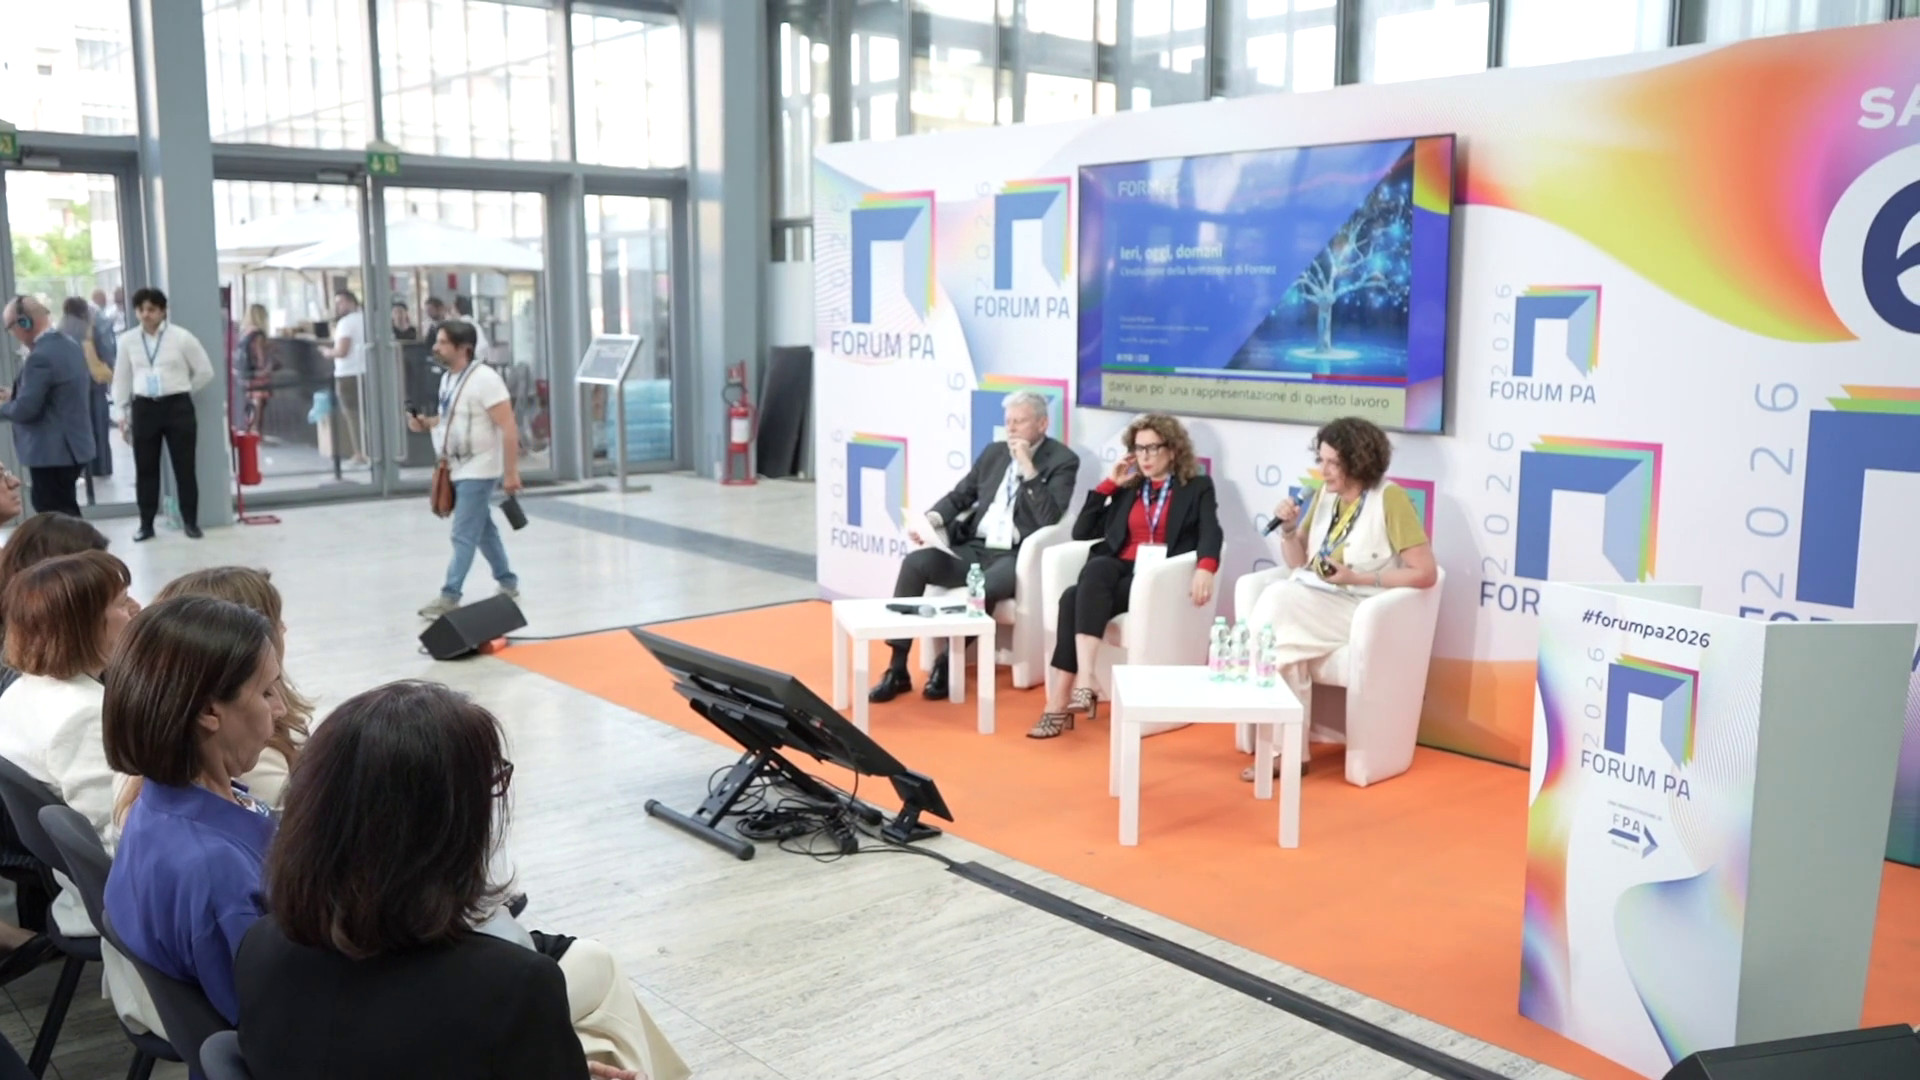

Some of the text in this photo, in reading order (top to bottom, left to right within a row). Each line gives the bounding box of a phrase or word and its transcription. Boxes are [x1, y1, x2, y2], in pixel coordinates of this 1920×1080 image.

[974, 295, 1071, 319] FORUM PA
[831, 330, 936, 360] FORUM PA
[1490, 284, 1513, 377] 2026
[1169, 386, 1189, 395] una
[1191, 387, 1287, 403] rappresentazione
[1290, 391, 1301, 403] di
[1304, 393, 1346, 406] questo
[1350, 394, 1390, 409] lavoro
[1489, 380, 1597, 404] FORUM PA
[947, 372, 966, 470] 026
[1481, 432, 1515, 576] 2026
[1739, 382, 1800, 599] 2026
[831, 528, 908, 559] FORUM PA
[1582, 609, 1711, 648] #forumpa2026
[1582, 647, 1605, 749] 2026
[1581, 749, 1691, 801] FORUM PA
[1612, 813, 1641, 834] FPA
